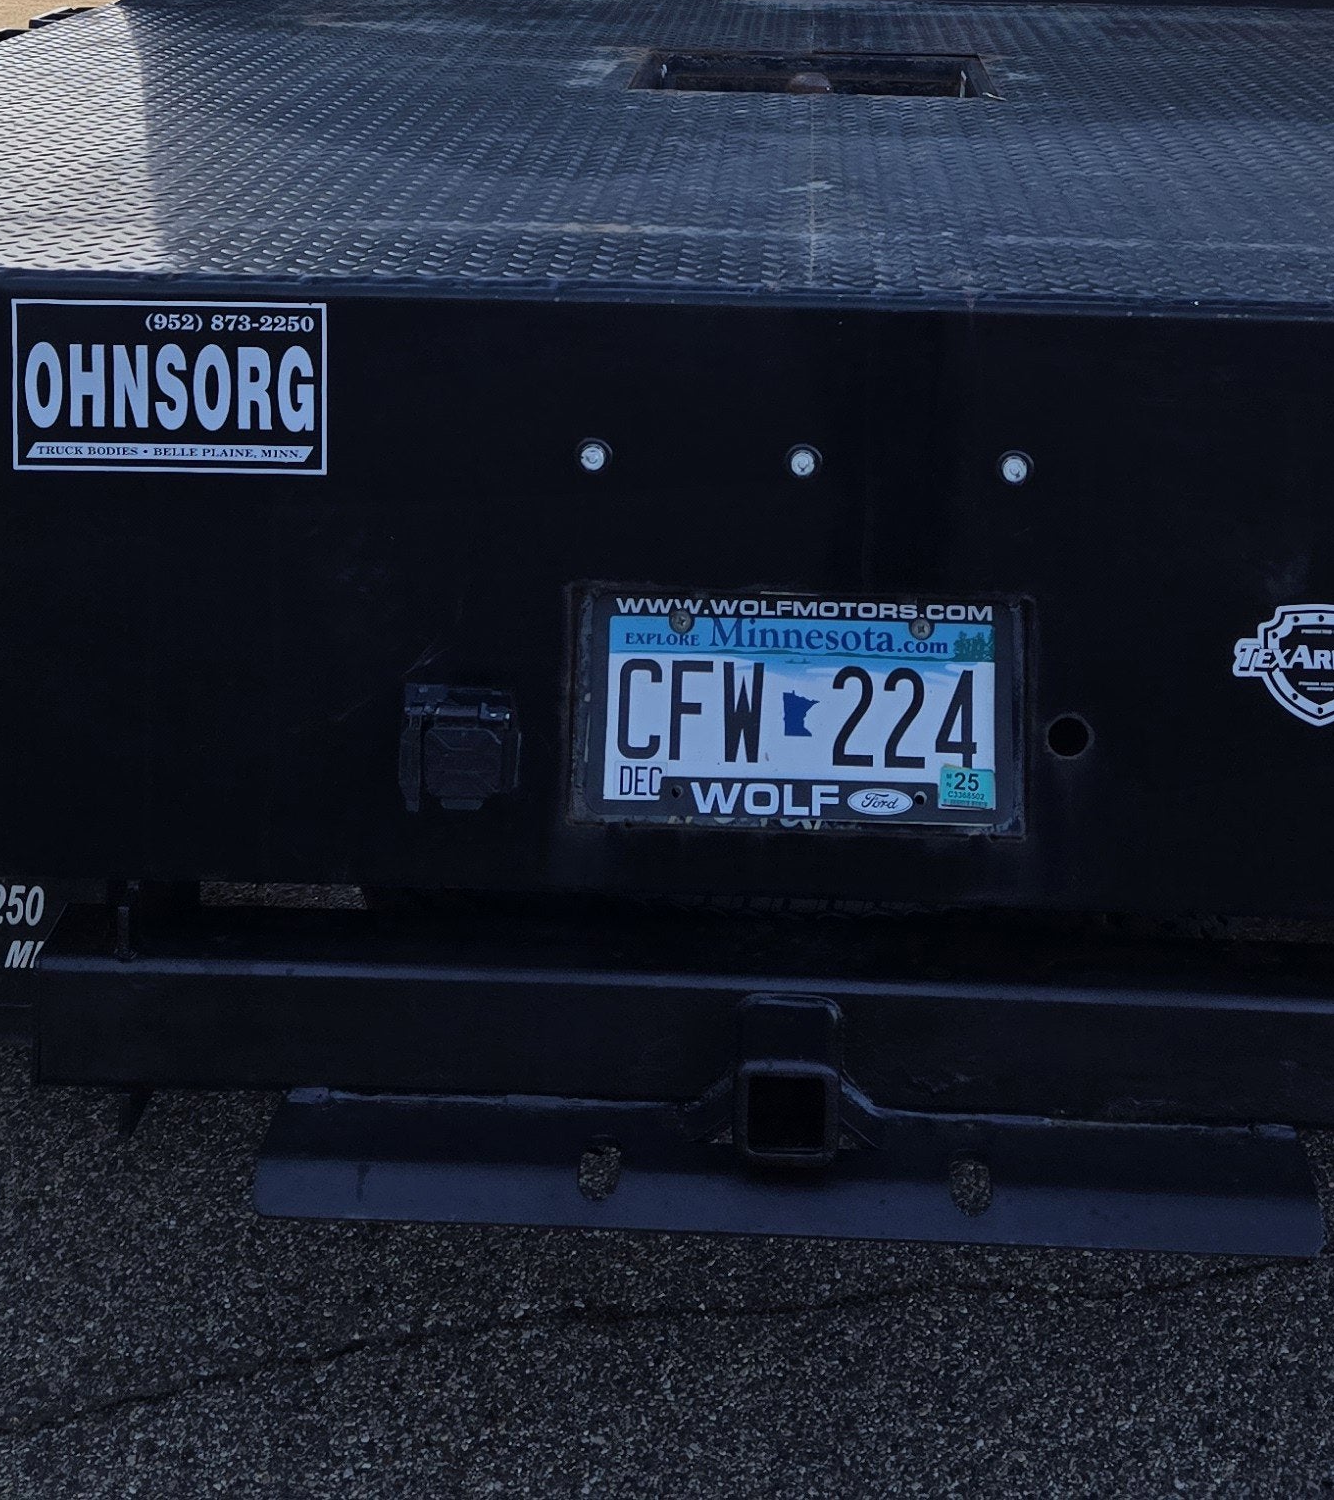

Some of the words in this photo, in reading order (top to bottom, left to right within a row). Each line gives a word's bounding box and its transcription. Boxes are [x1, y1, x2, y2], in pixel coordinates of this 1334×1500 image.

[145, 313, 203, 333] (952)
[210, 314, 315, 333] 873-2250
[24, 341, 315, 432] OHNSORG
[36, 445, 83, 456] TRUCK
[87, 446, 138, 457] BODIES
[153, 447, 198, 458] BELLE
[201, 448, 257, 460] PLAINE,
[260, 449, 303, 460] MINN.
[616, 597, 993, 622] WWW.WOLFMOTORS.COM
[625, 632, 700, 647] EXPLORE
[617, 658, 765, 764] CFW
[832, 666, 978, 769] 224
[620, 765, 663, 797] DEC
[954, 772, 980, 792] 25
[691, 782, 840, 816] WOLF
[861, 793, 899, 809] Ford
